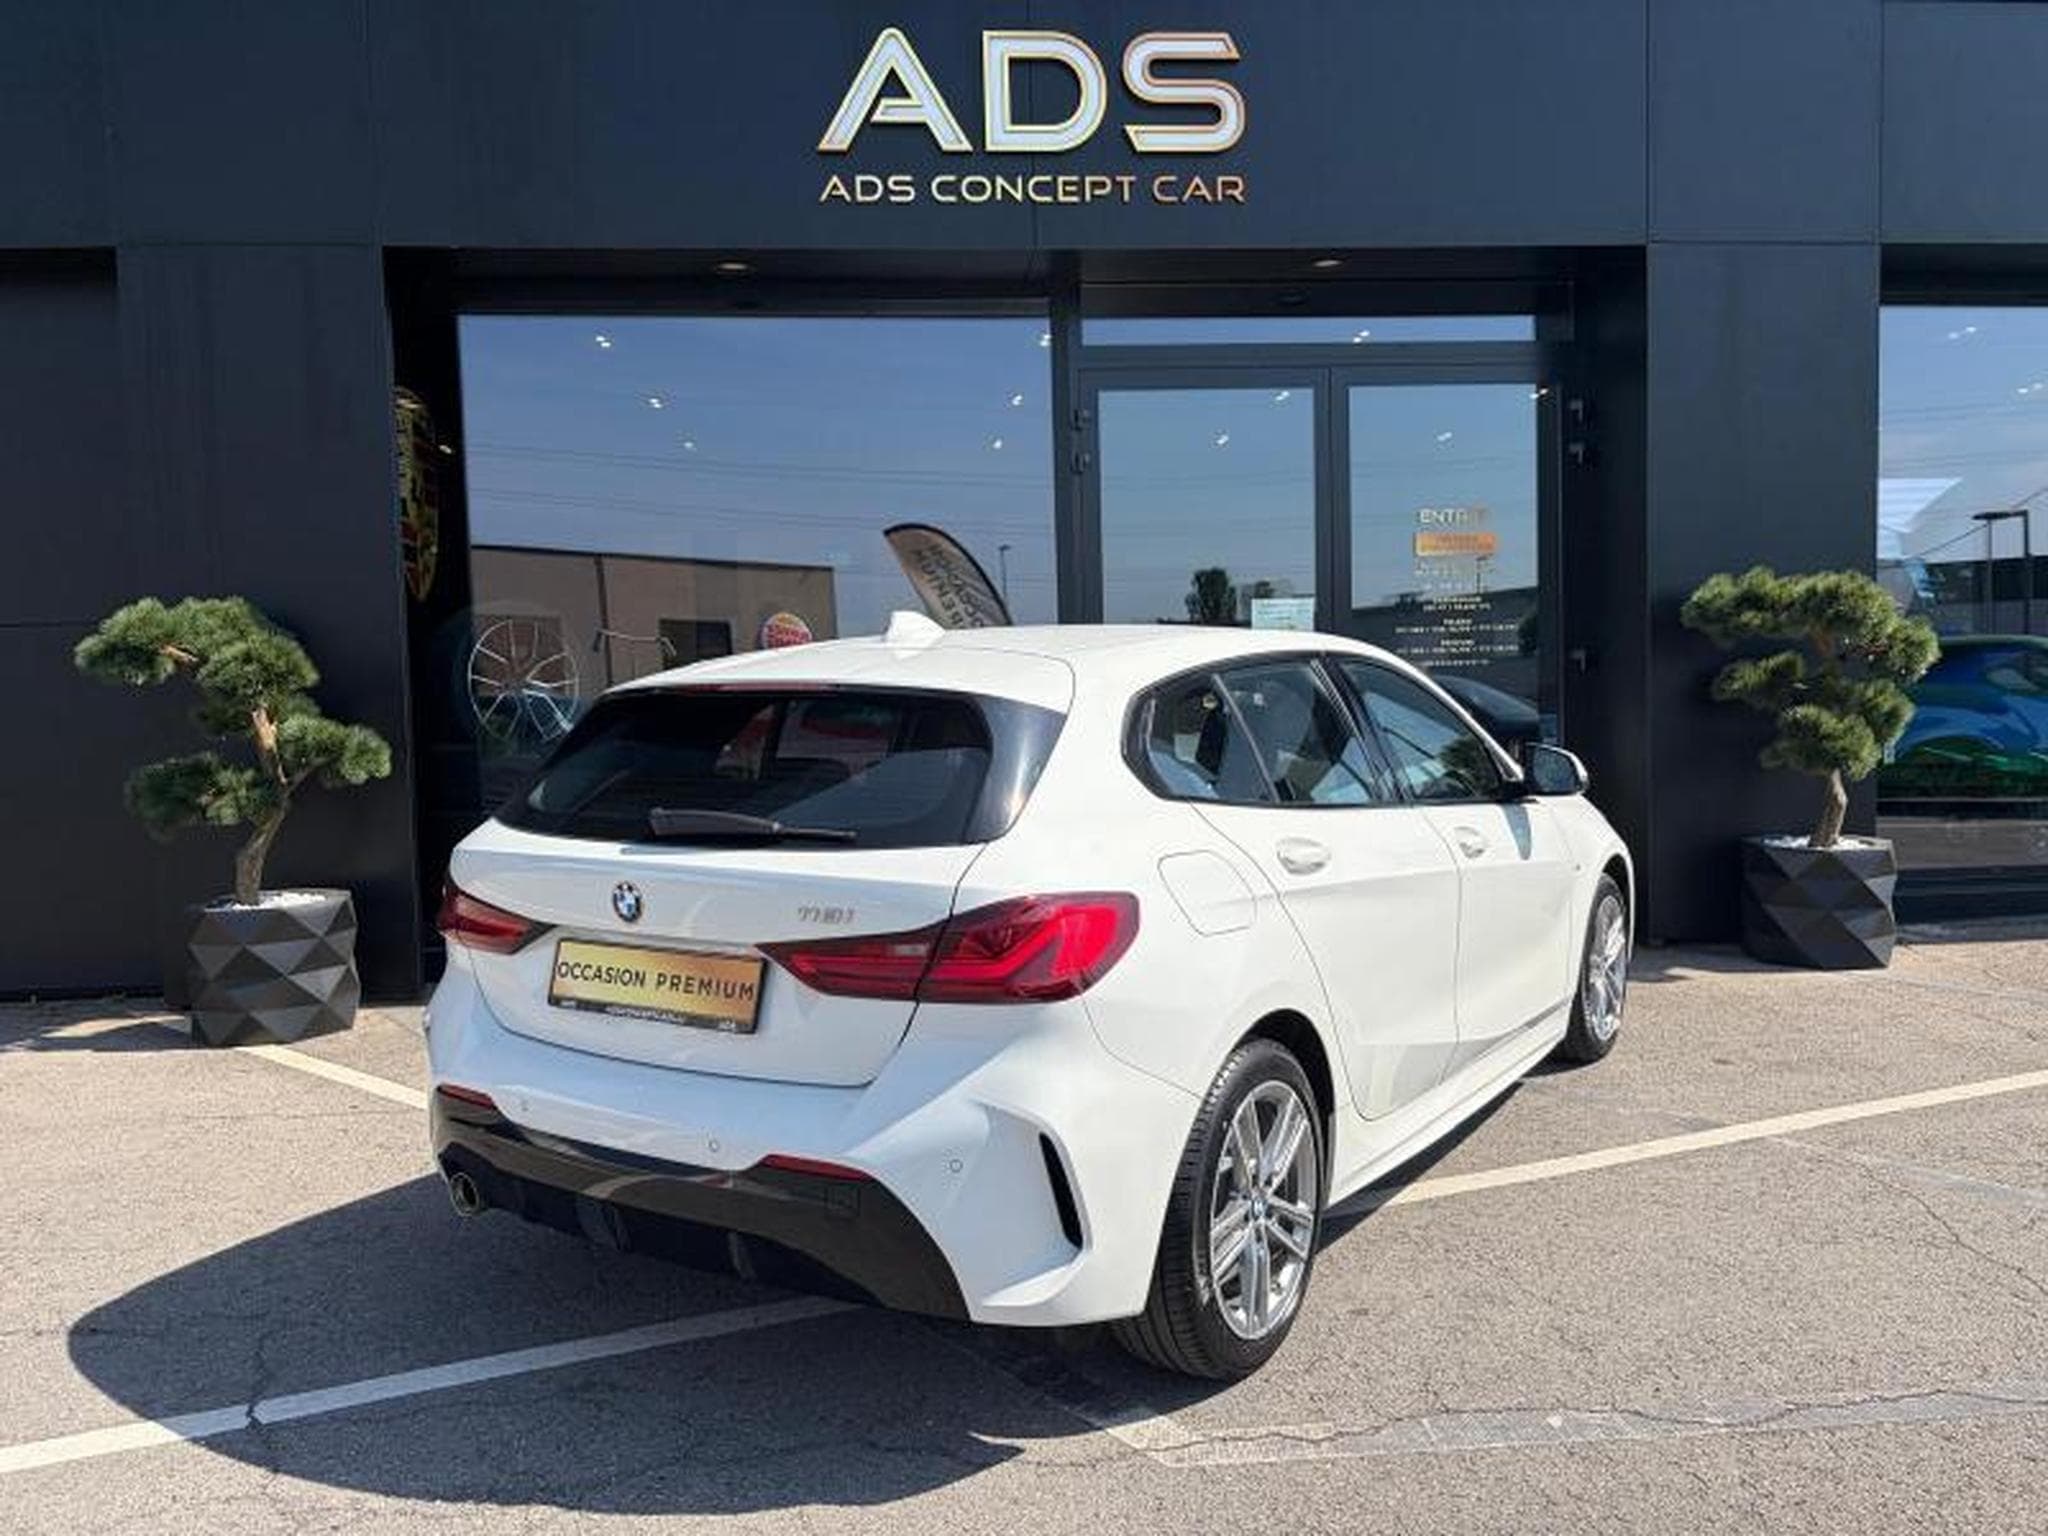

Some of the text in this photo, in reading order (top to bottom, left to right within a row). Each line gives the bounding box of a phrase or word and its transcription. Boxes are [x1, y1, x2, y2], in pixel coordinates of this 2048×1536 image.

[818, 27, 1246, 153] ADS
[819, 174, 1246, 204] ADS CONCEPT CAR
[556, 961, 755, 1000] OCCASION PREMIUM
